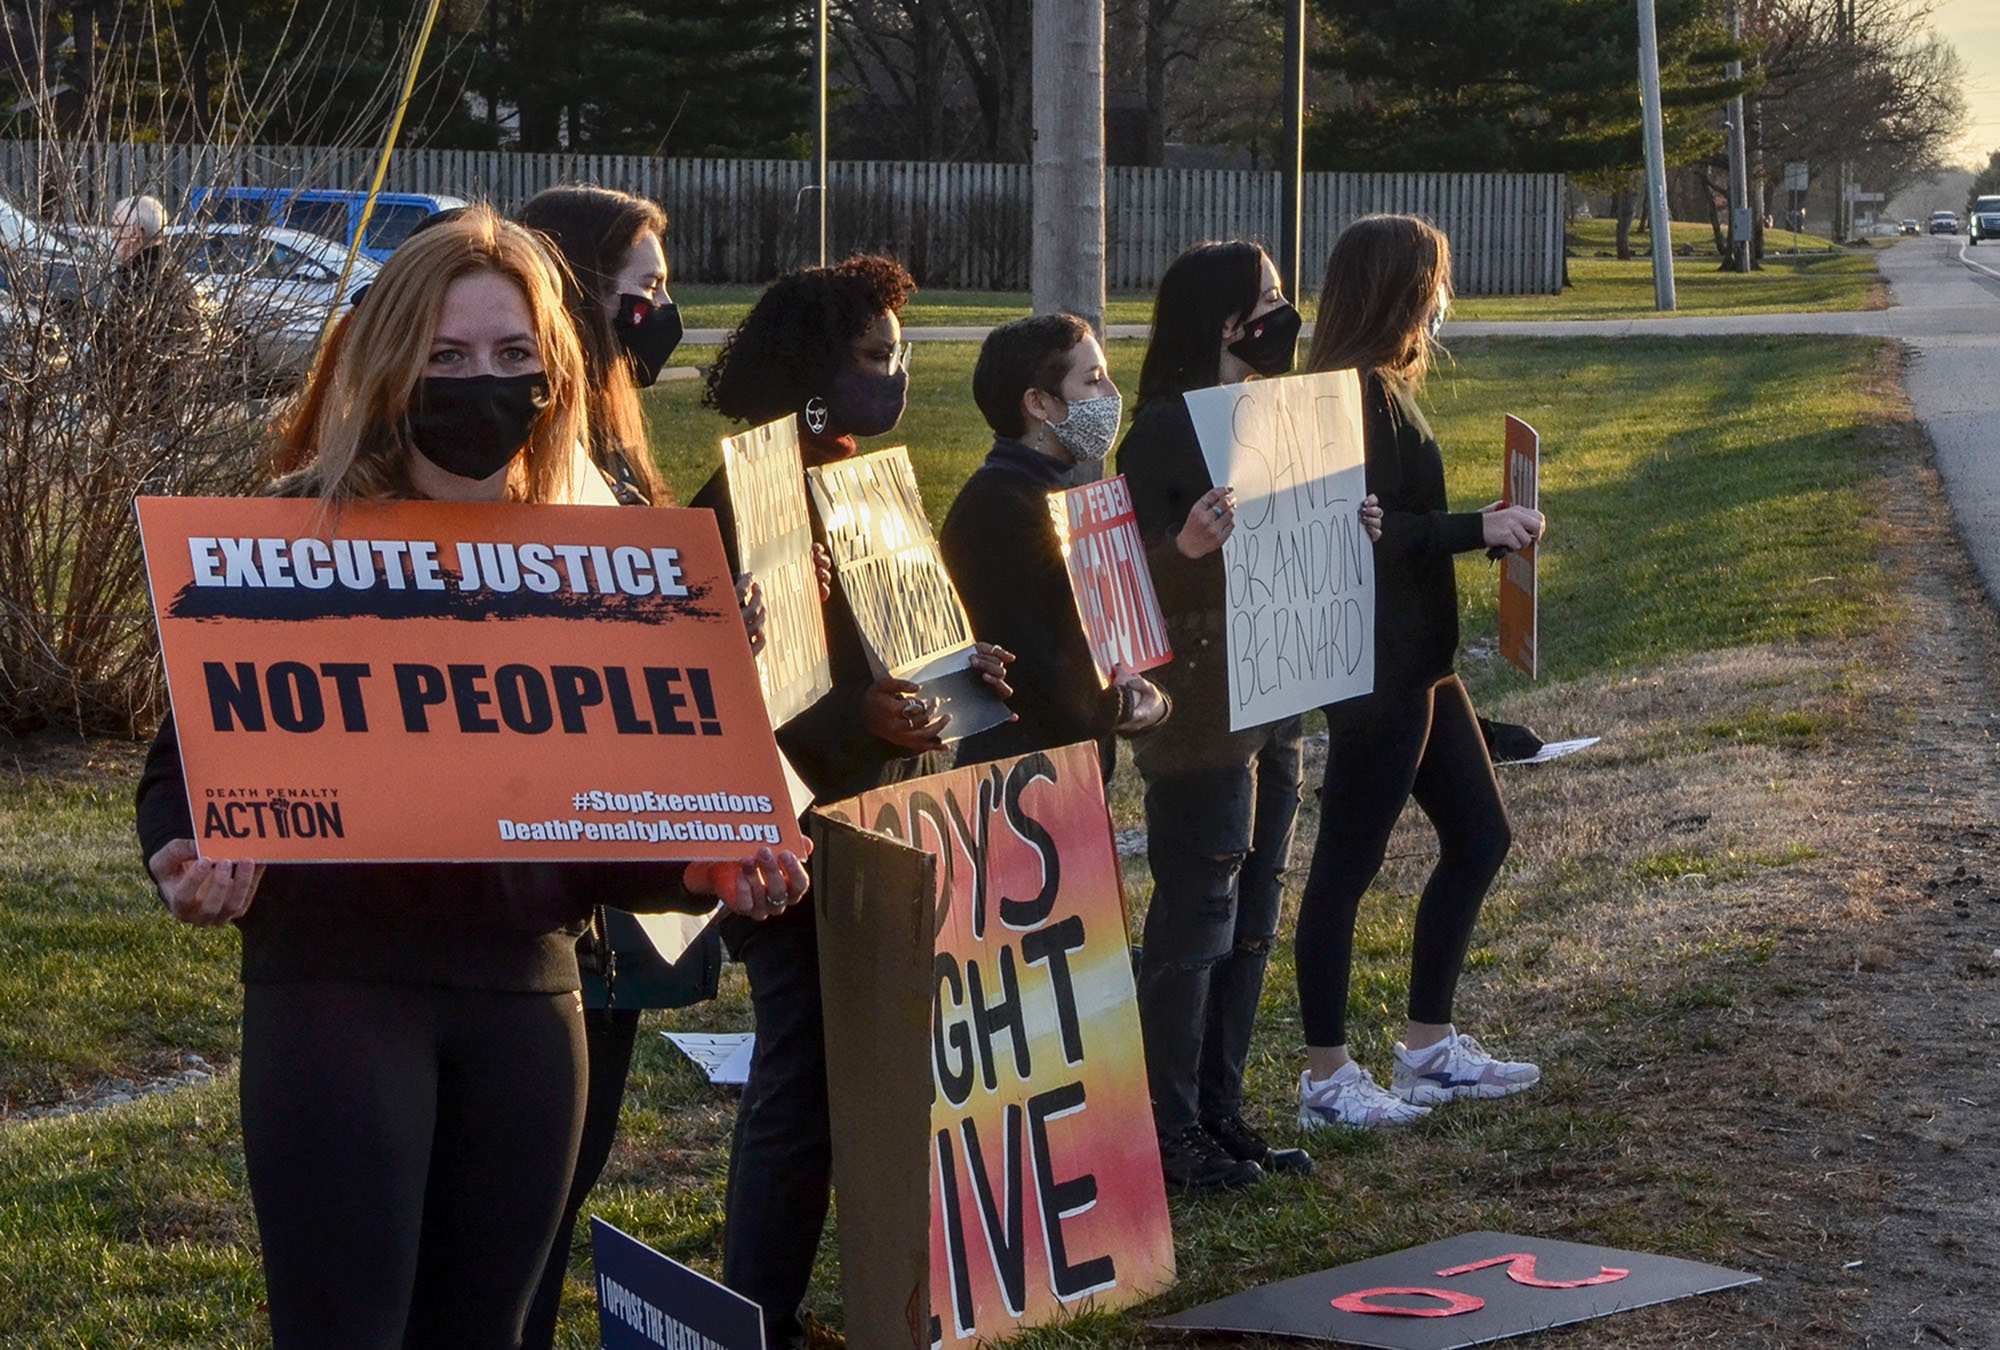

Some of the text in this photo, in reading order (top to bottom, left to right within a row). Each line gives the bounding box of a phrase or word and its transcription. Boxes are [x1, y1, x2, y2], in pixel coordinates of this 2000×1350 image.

[1232, 395, 1348, 530] SAVE
[188, 536, 689, 597] EXECUTE JUSTICE
[1226, 512, 1363, 608] BRANDON
[1232, 598, 1364, 711] BERNARD
[203, 660, 722, 736] NOT PEOPLE!
[204, 798, 344, 839] ACTION
[205, 788, 339, 798] DEATH PENALTY
[571, 790, 773, 813] #StopExecutions
[498, 819, 781, 844] DeathPenaltyAction.org
[600, 1272, 607, 1308] I
[606, 1276, 646, 1334] OPPOSE
[643, 1300, 665, 1347] THE
